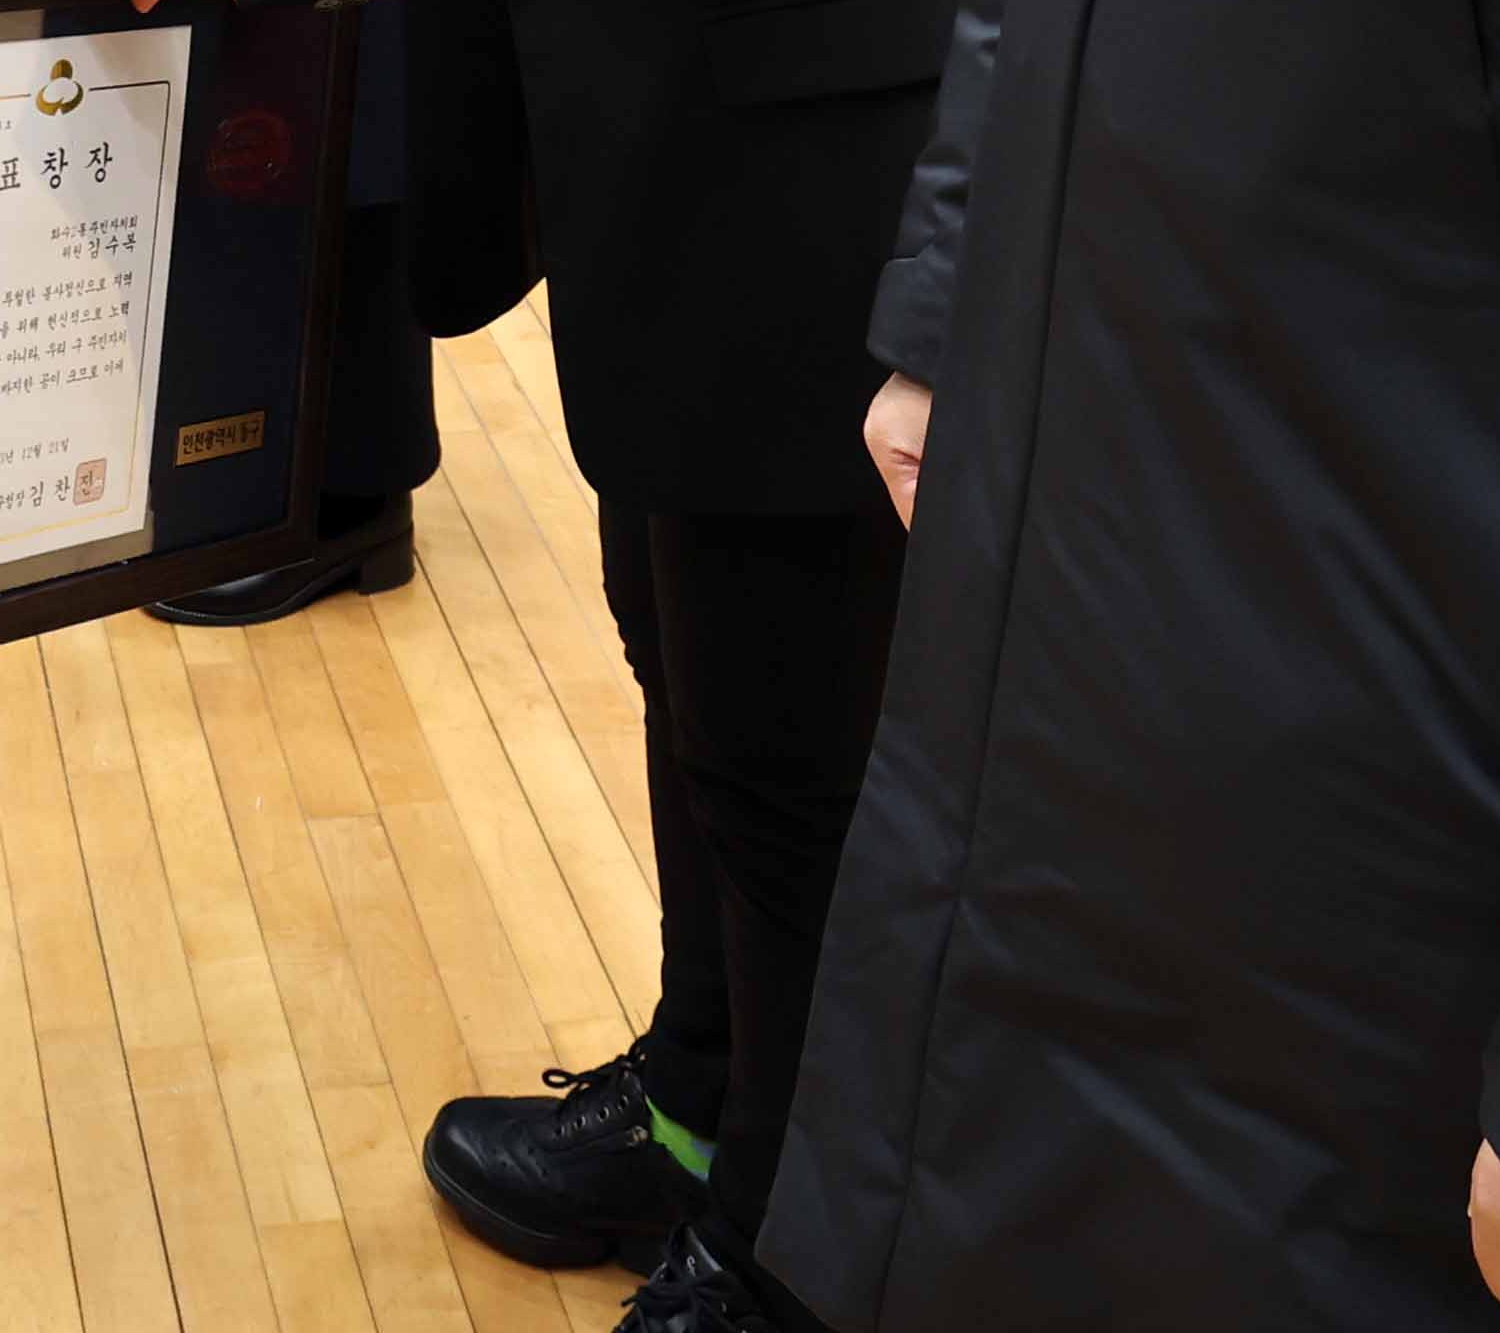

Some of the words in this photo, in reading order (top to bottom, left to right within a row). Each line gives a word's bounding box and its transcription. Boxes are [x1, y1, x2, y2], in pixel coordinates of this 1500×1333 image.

[48, 307, 102, 330] 헌신적으로
[45, 340, 66, 357] 우리
[71, 337, 82, 353] 구
[66, 365, 99, 383] 크므로
[104, 357, 123, 375] 이에
